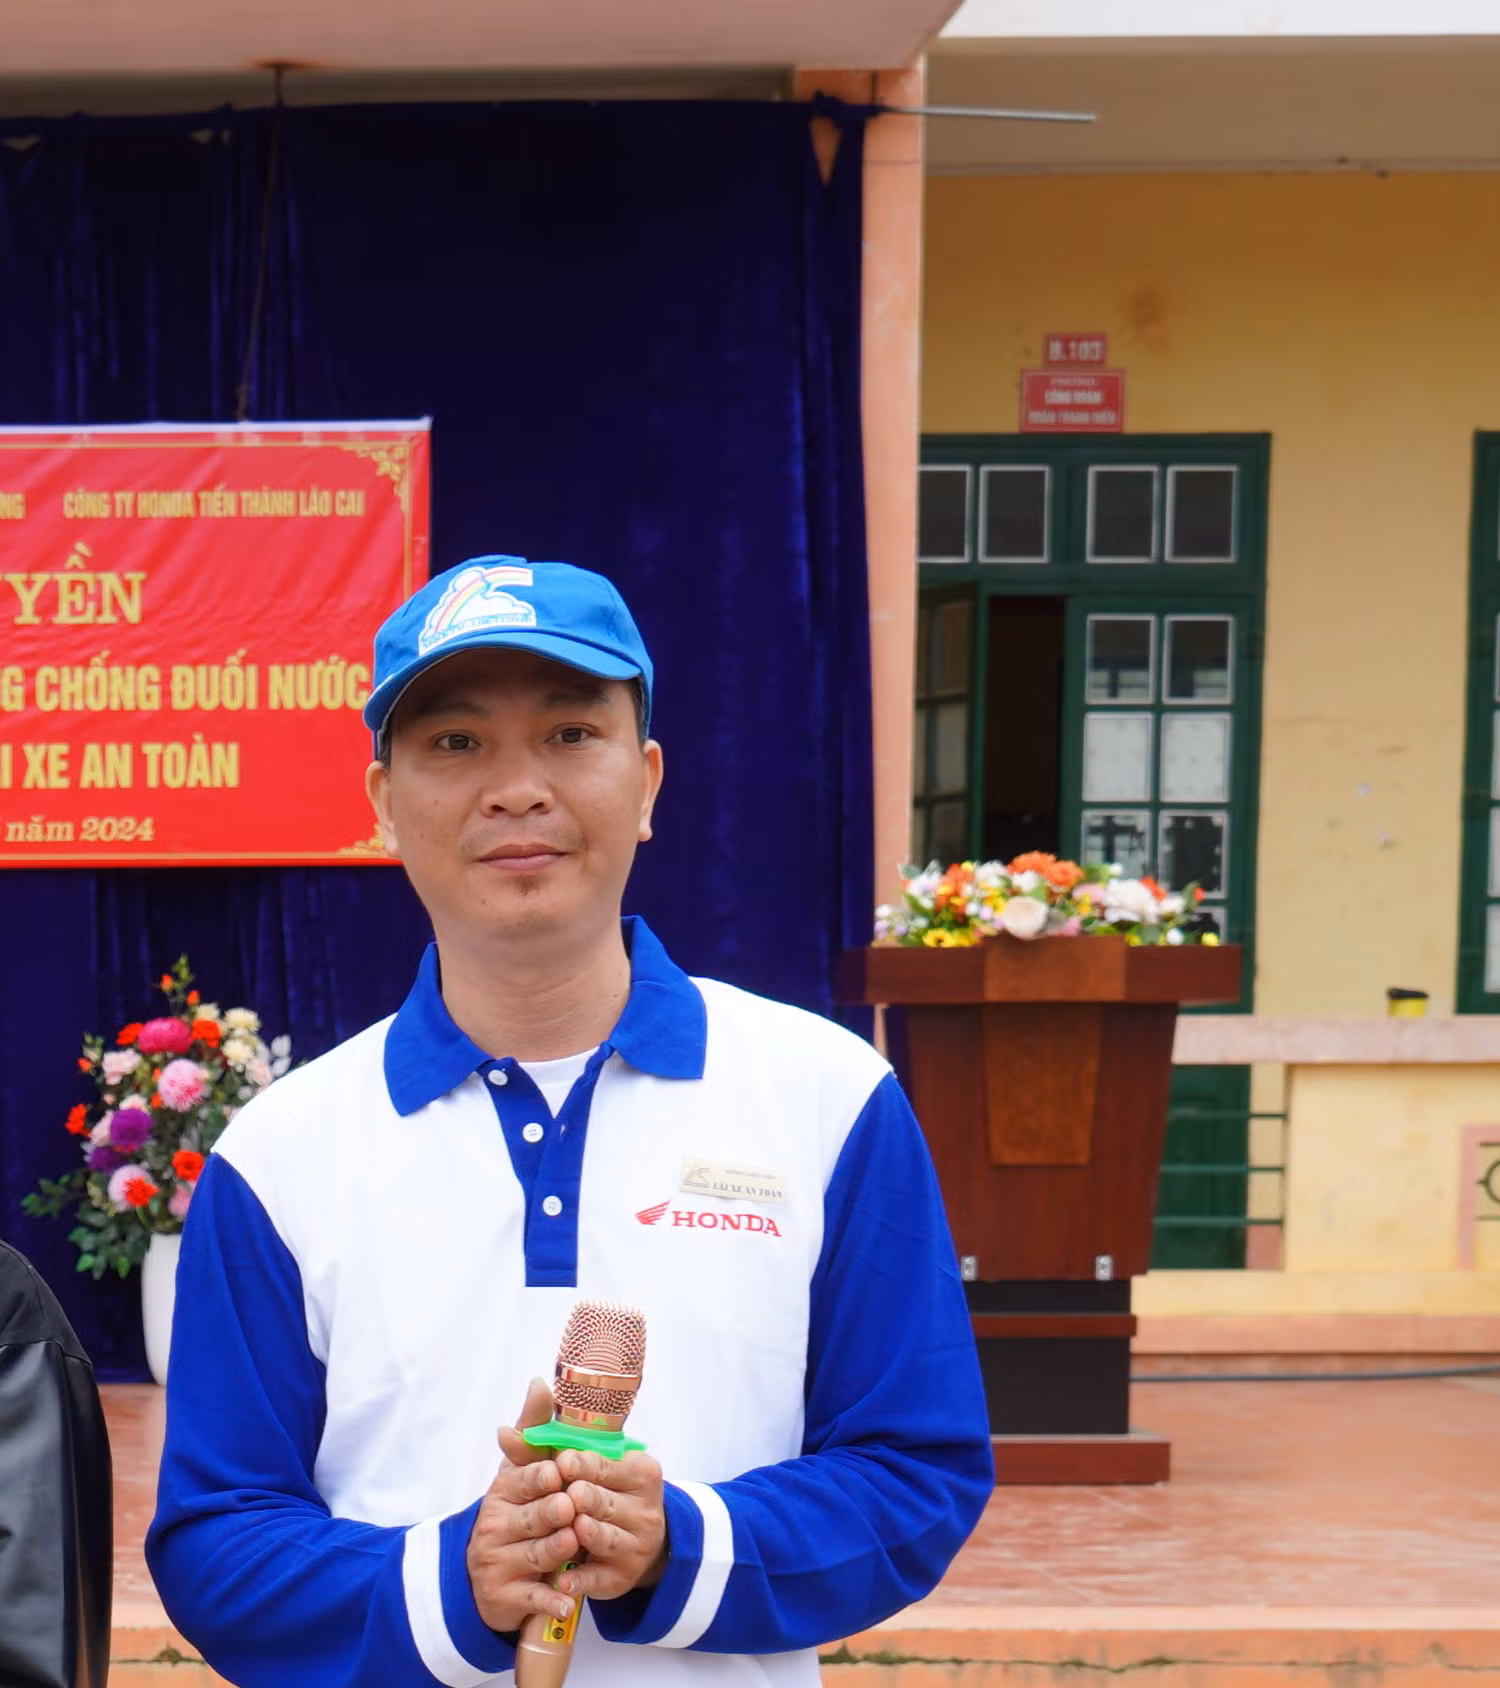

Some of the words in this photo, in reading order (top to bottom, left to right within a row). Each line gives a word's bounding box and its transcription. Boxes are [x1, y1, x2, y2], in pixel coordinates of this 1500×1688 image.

[64, 487, 111, 518] CÔNG
[114, 492, 133, 518] TY
[199, 483, 236, 518] TIẾN
[240, 486, 296, 517] THÀNH
[300, 485, 331, 517] LÀO
[334, 490, 365, 517] CAI
[35, 649, 160, 711] CHỐNG
[170, 649, 260, 710] ĐUỐI
[268, 654, 370, 710] NƯỚC
[23, 742, 70, 789] XE
[80, 742, 132, 789] AN
[142, 733, 240, 788] TOÀN
[5, 814, 75, 843] năm
[79, 816, 155, 843] 2024
[671, 1210, 782, 1237] HONDA
